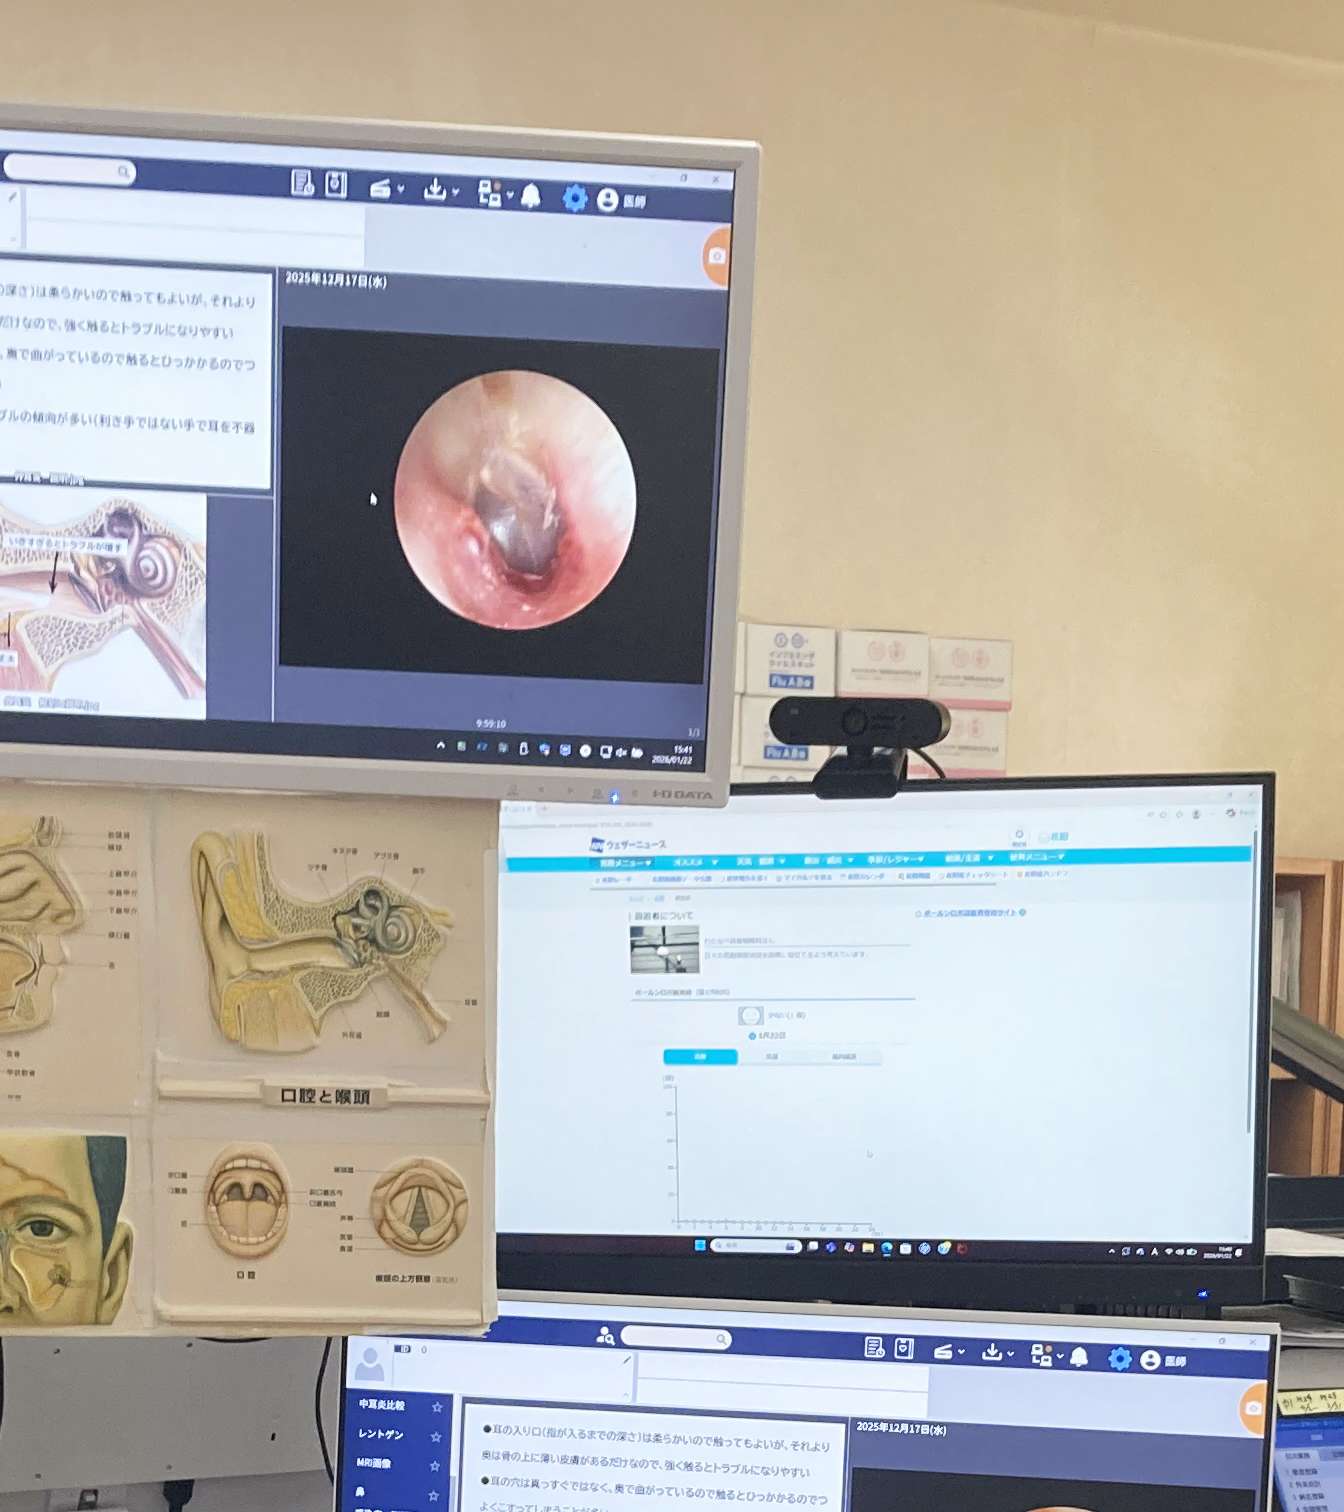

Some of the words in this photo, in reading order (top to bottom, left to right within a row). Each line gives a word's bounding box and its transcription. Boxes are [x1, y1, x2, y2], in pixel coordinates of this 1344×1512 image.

[285, 270, 387, 290] 2025年12月17日(水)
[476, 719, 507, 729] 9:59:10
[651, 754, 692, 765] 2026/01/22
[281, 1088, 371, 1105] 口腔と喉頭
[359, 1399, 405, 1412] 中耳炎比較
[358, 1429, 404, 1440] レントゲン
[856, 1420, 947, 1437] 2025年12月17日(水)
[356, 1458, 391, 1469] MRI画像
